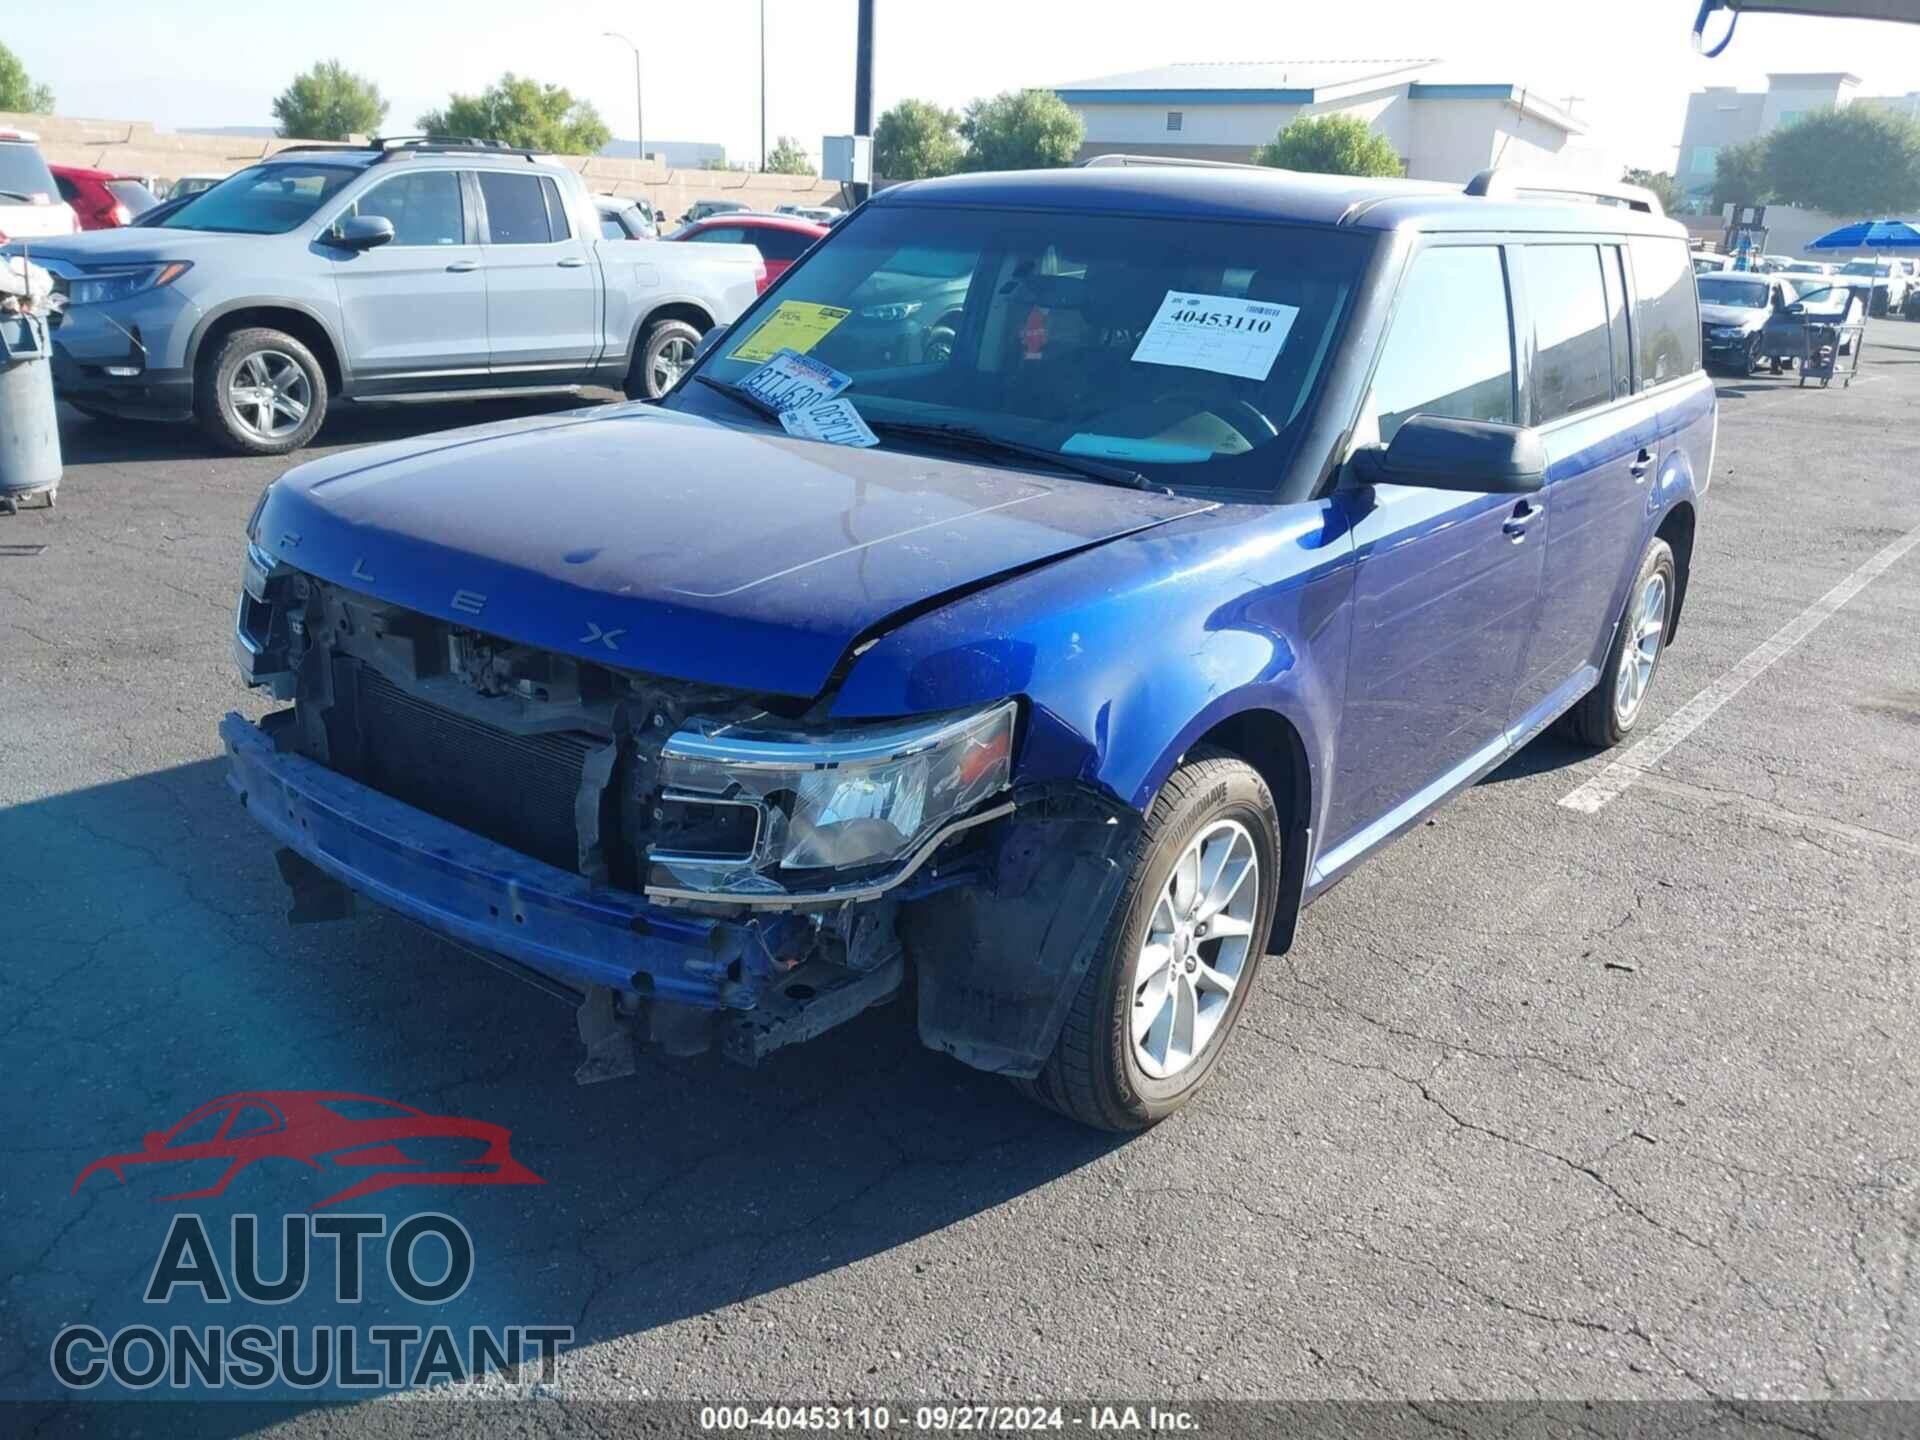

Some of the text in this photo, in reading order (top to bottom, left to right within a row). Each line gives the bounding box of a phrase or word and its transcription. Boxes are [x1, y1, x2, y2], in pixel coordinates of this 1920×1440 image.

[1170, 310, 1272, 333] 40453110
[748, 367, 823, 410] 8TTJ630
[809, 404, 866, 443] TTJ630
